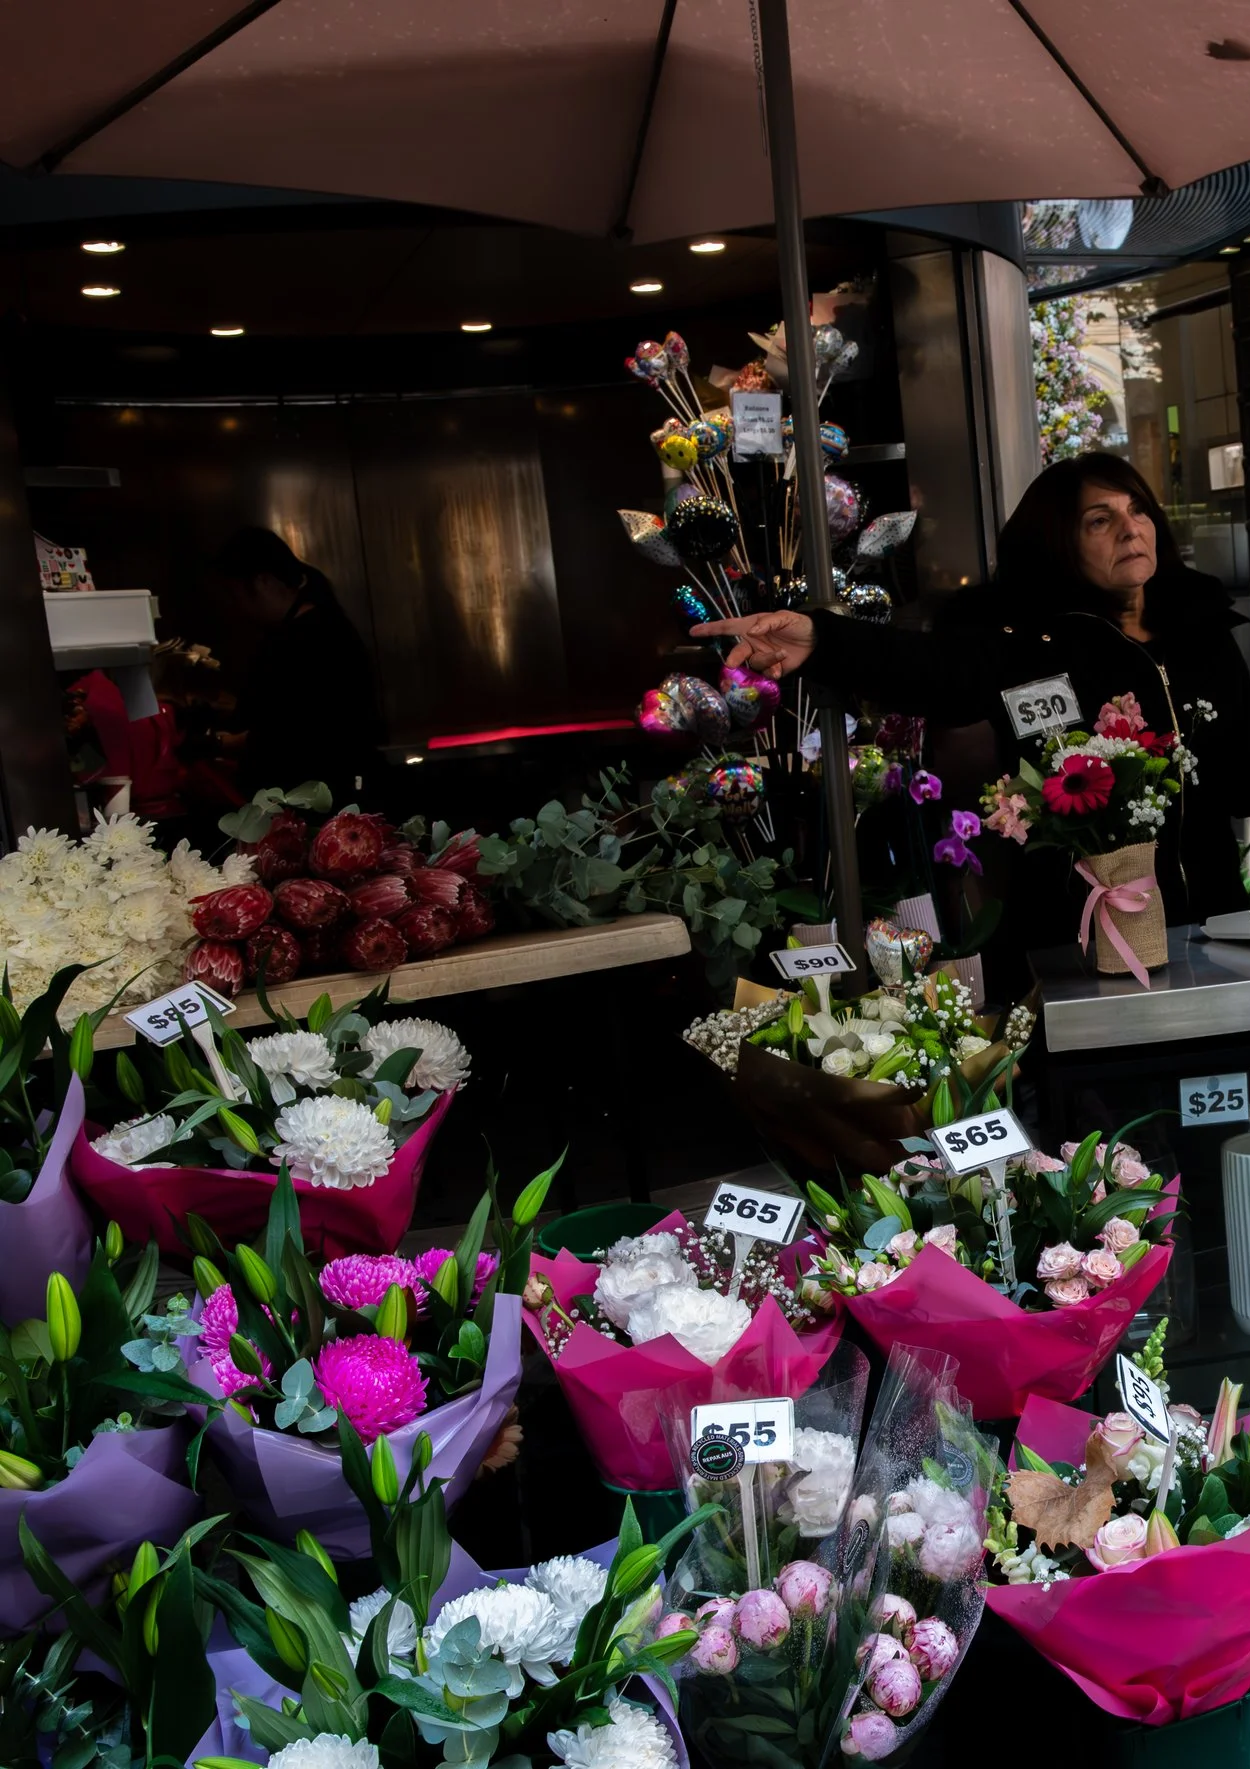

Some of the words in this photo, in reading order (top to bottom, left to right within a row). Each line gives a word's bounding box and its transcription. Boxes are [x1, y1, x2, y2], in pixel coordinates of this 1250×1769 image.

[1018, 694, 1067, 726] $30
[794, 956, 839, 971] $90
[147, 998, 200, 1030] $85
[1188, 1088, 1244, 1118] $25
[944, 1119, 1008, 1154] $65
[713, 1192, 782, 1224] $65
[1128, 1367, 1157, 1419] $95
[702, 1455, 721, 1464] REPAK
[721, 1451, 733, 1459] AUS
